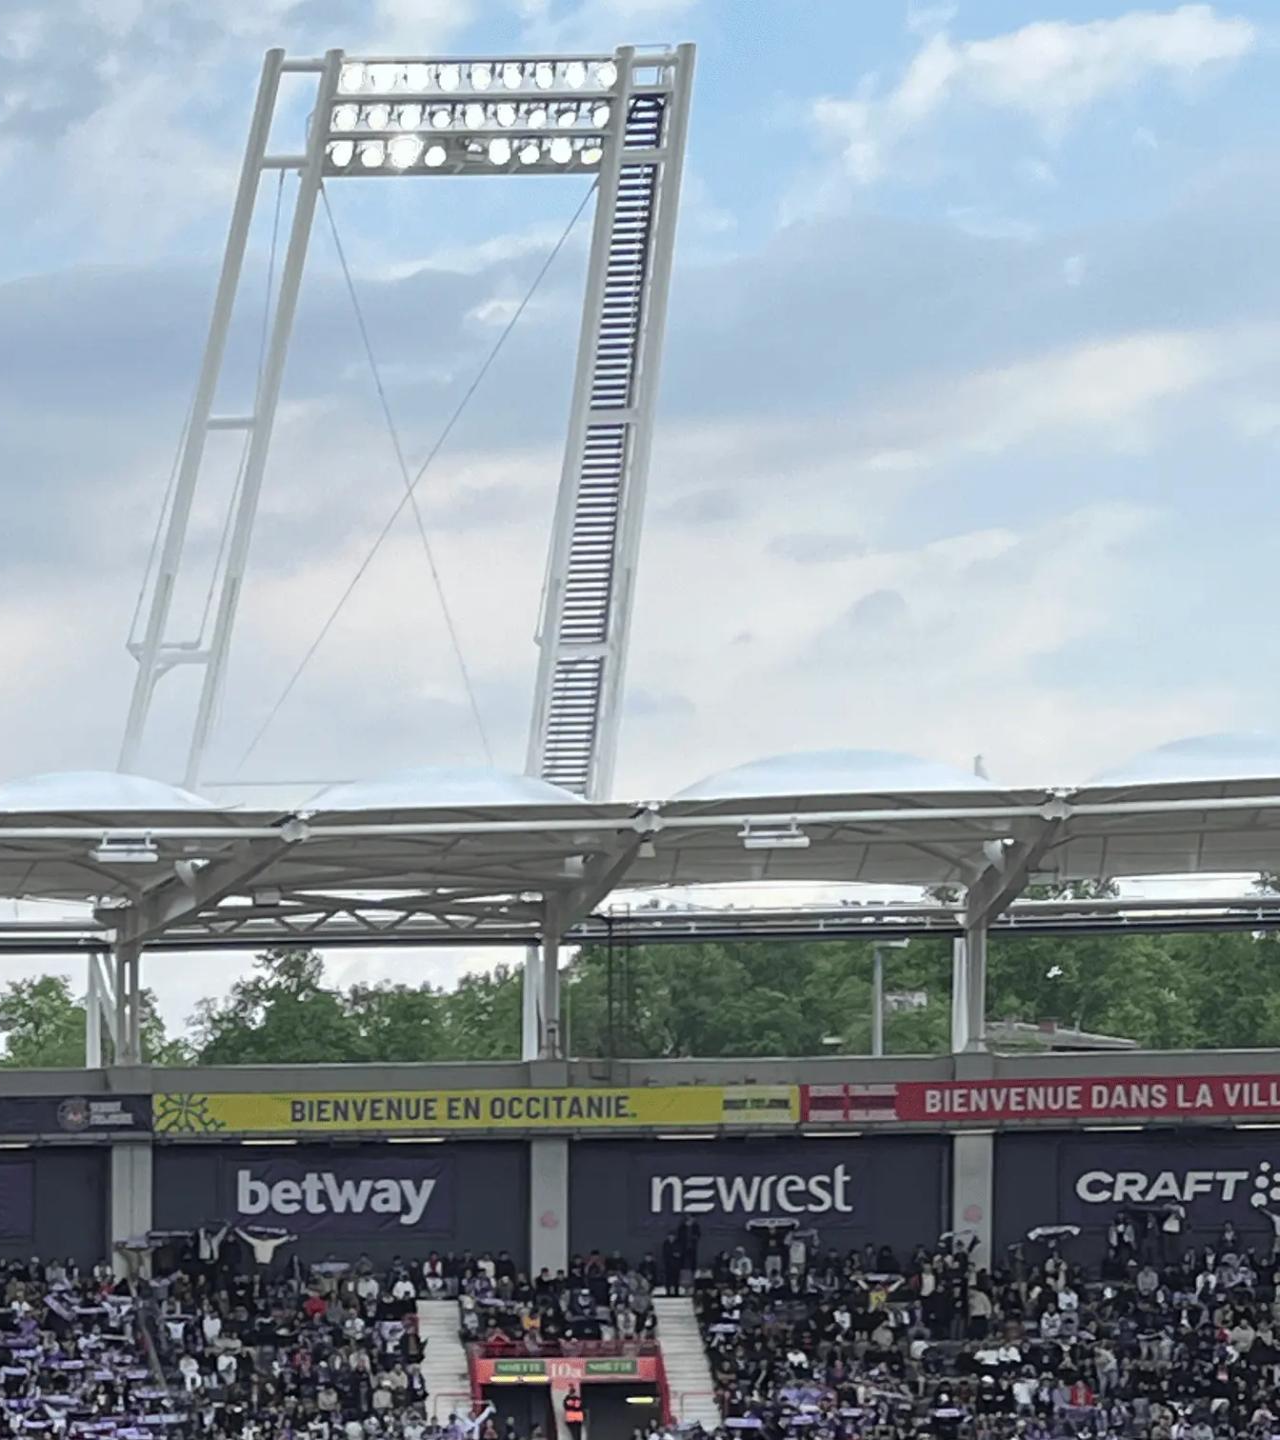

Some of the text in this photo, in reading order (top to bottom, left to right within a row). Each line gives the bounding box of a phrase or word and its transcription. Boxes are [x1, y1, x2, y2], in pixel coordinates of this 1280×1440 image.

[290, 1097, 437, 1123] BIENVENUE
[446, 1097, 480, 1120] EN
[925, 1085, 1083, 1113] BIENVENUE
[1091, 1084, 1168, 1109] DANS
[1176, 1082, 1213, 1109] LA
[237, 1169, 437, 1224] betway
[1075, 1171, 1250, 1203] CRAFT
